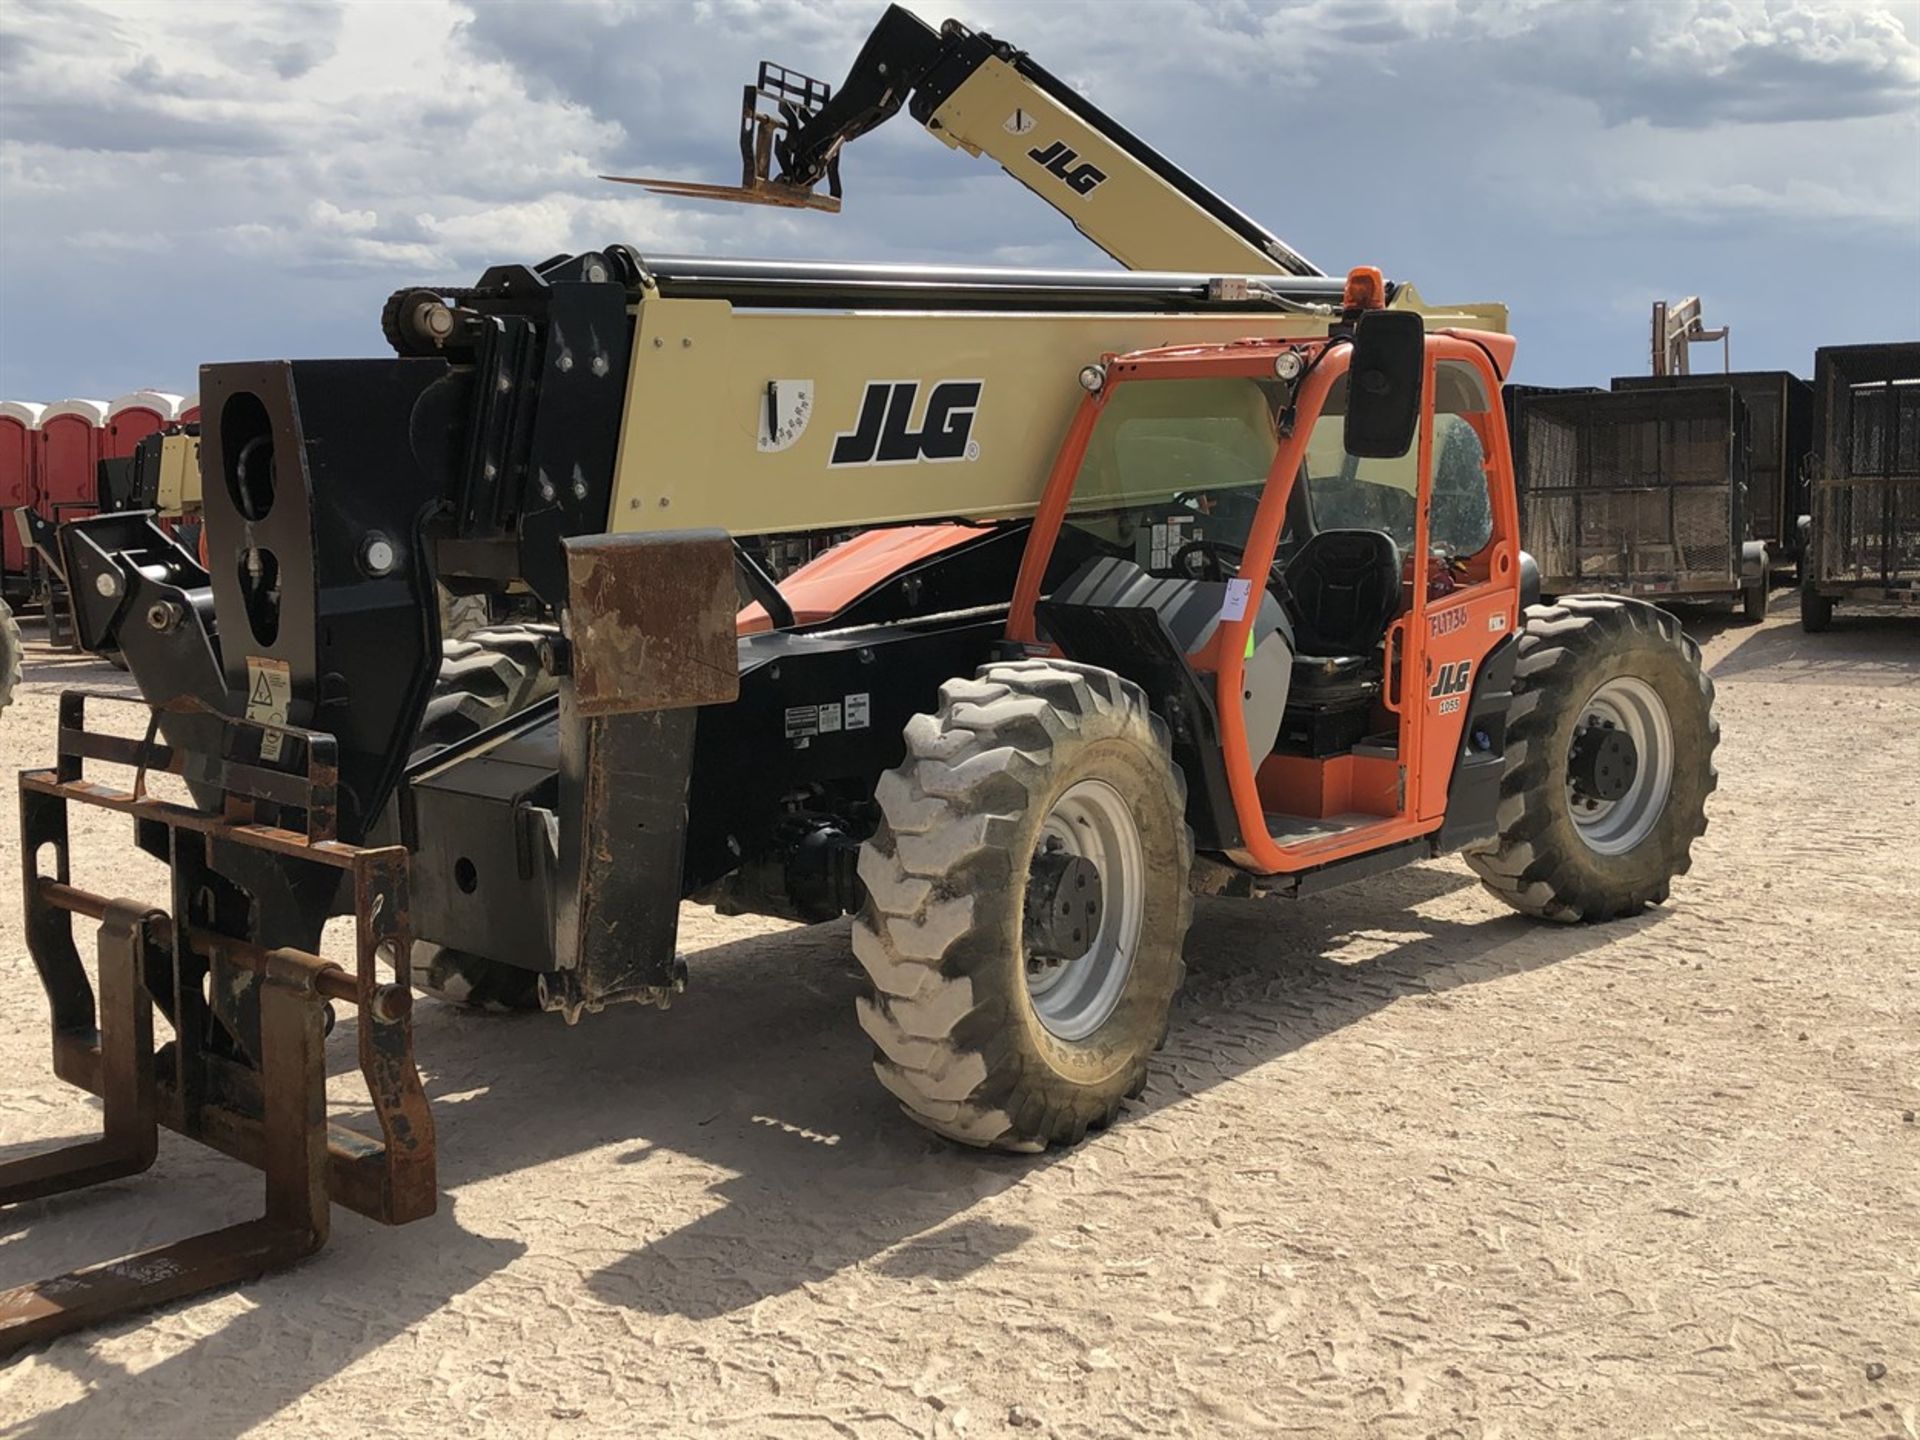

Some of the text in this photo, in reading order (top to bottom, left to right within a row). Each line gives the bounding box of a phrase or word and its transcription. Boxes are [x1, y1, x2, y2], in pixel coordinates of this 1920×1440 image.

[1026, 140, 1108, 196] JLG
[829, 381, 983, 467] JLG
[1430, 660, 1472, 698] JLG
[1440, 699, 1460, 714] 1055
